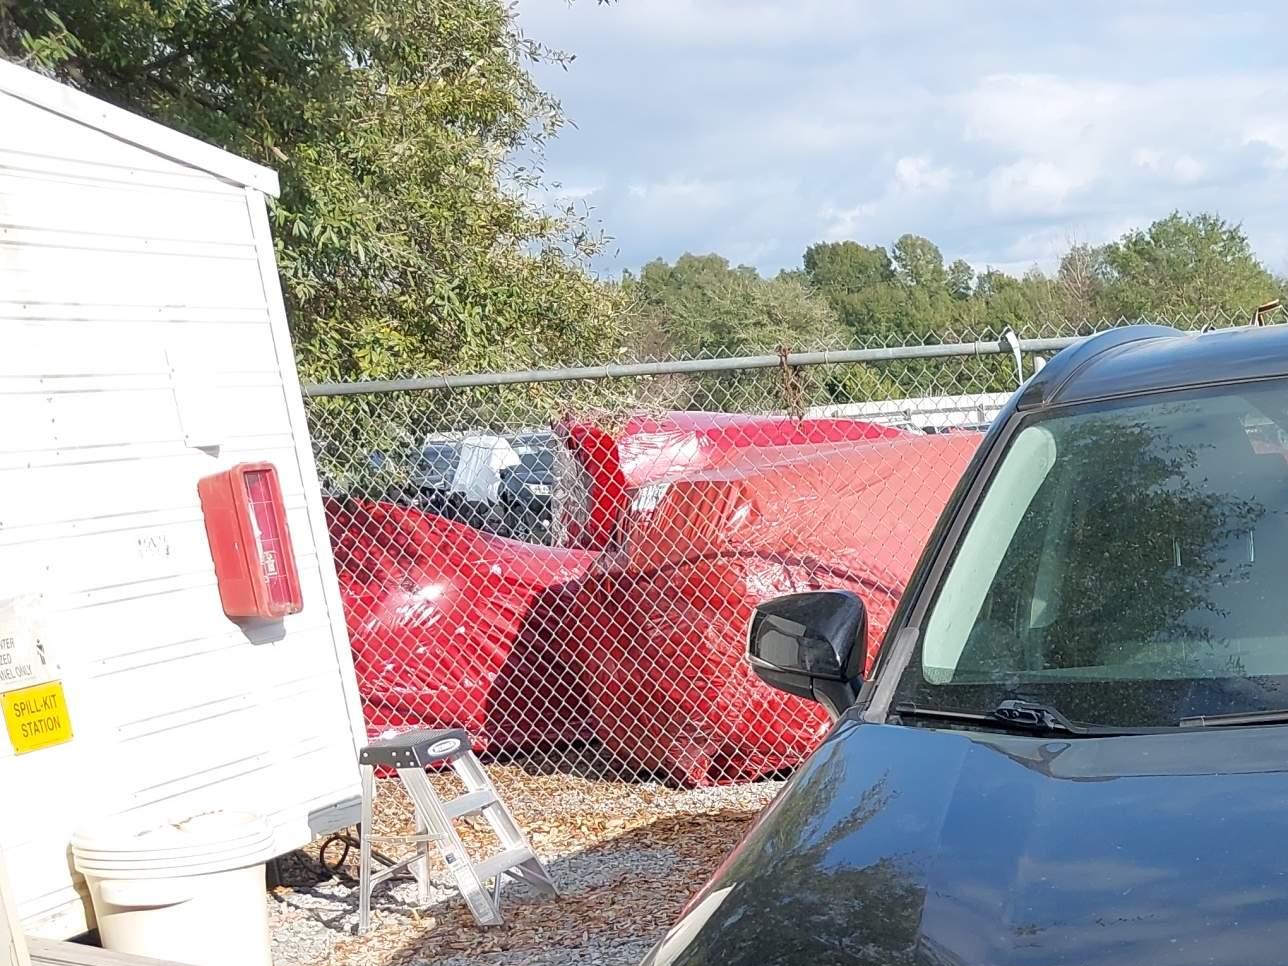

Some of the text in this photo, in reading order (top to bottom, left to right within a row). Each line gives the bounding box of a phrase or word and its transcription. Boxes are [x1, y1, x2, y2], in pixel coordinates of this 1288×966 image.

[15, 664, 33, 677] ONLY
[13, 694, 58, 718] SPILL-KIT
[21, 715, 62, 738] STATION
